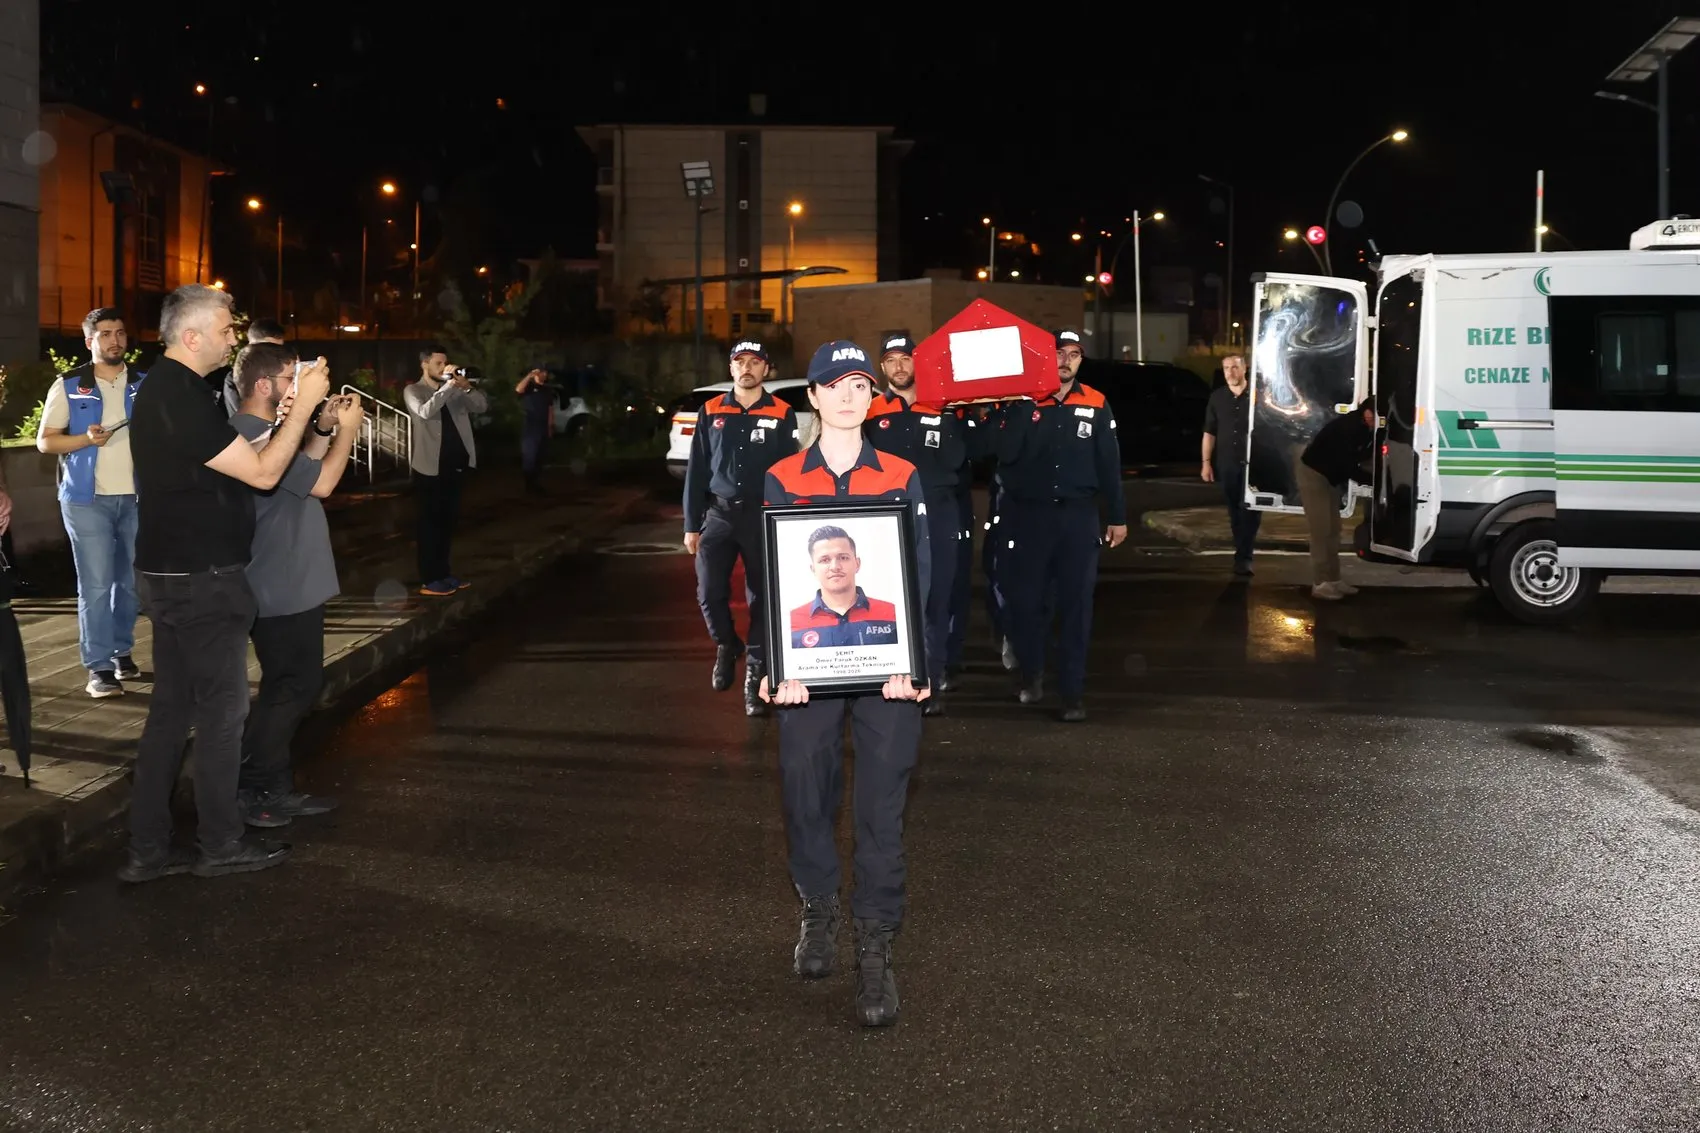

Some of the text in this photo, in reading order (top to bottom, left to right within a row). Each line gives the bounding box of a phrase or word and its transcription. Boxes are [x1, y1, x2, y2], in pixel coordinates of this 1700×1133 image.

[831, 347, 866, 362] AFAD
[1464, 367, 1530, 384] CENAZE
[866, 624, 892, 635] AFAD
